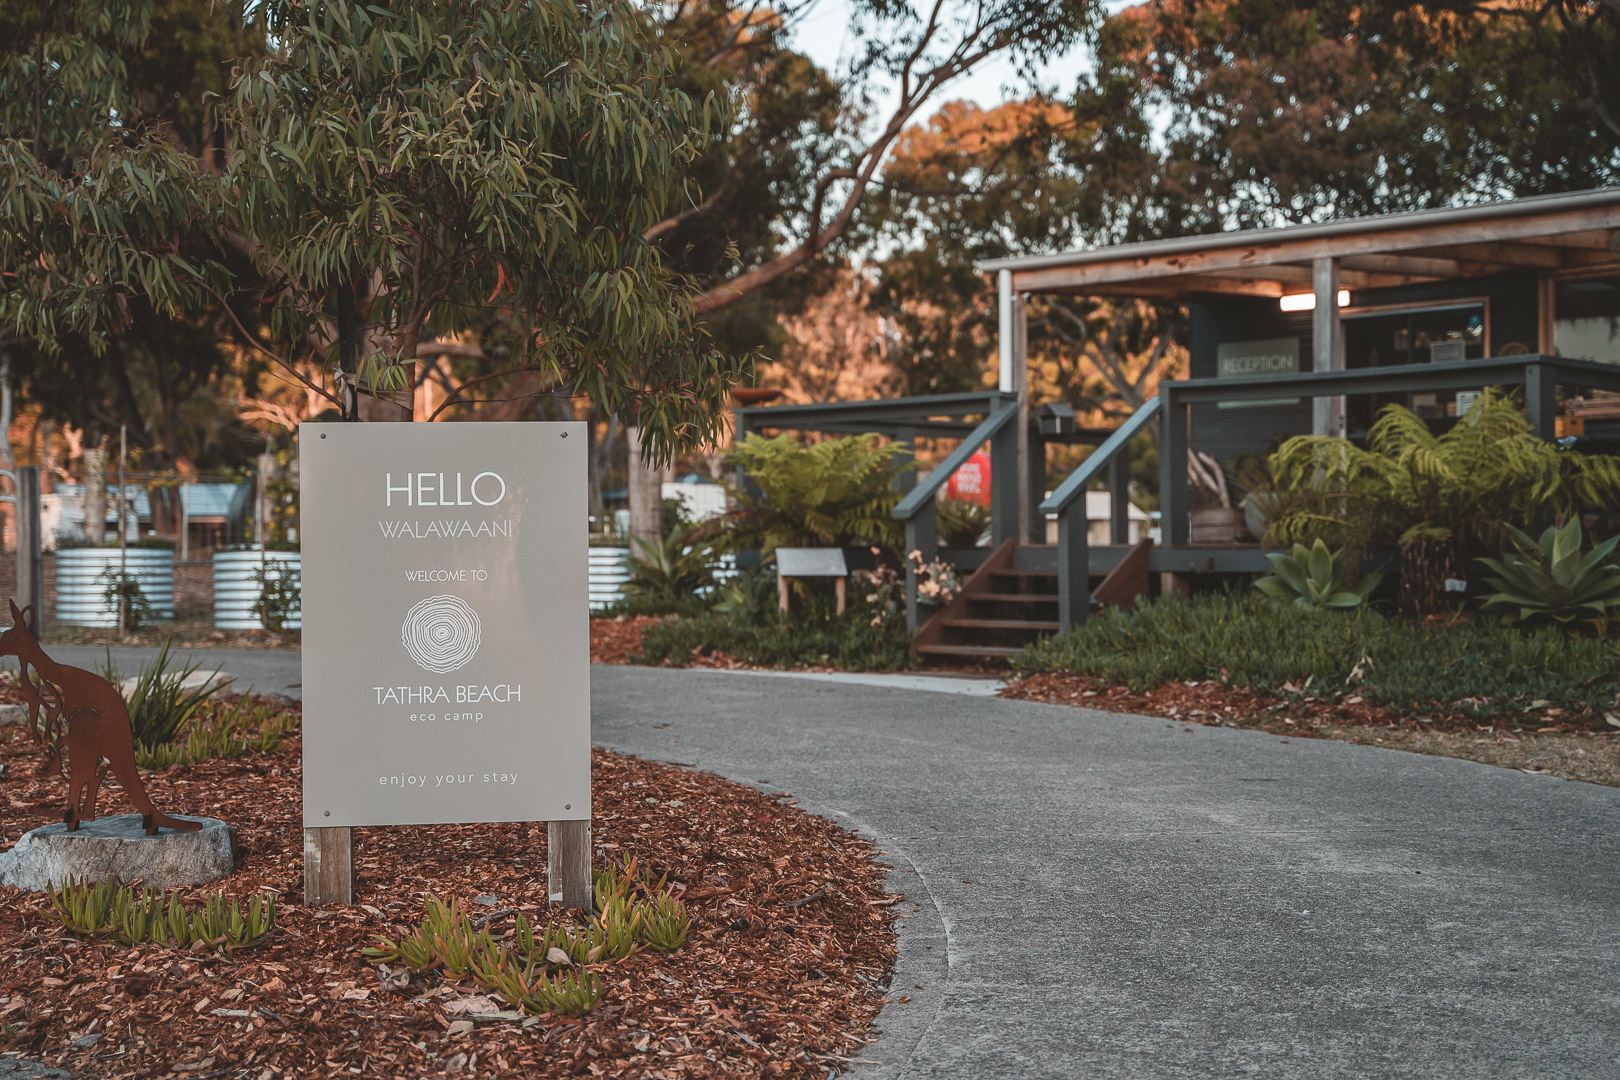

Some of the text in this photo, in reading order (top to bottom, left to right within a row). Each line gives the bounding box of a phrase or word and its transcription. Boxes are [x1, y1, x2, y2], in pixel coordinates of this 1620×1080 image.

[1222, 354, 1294, 373] RECEPTION
[386, 471, 506, 507] HELLO
[379, 519, 512, 539] WALAWAANI
[405, 569, 488, 582] WELCOME TO
[373, 684, 521, 705] TATHRA BEACH
[409, 712, 484, 723] eco camp
[379, 771, 519, 788] enjoy your stay
